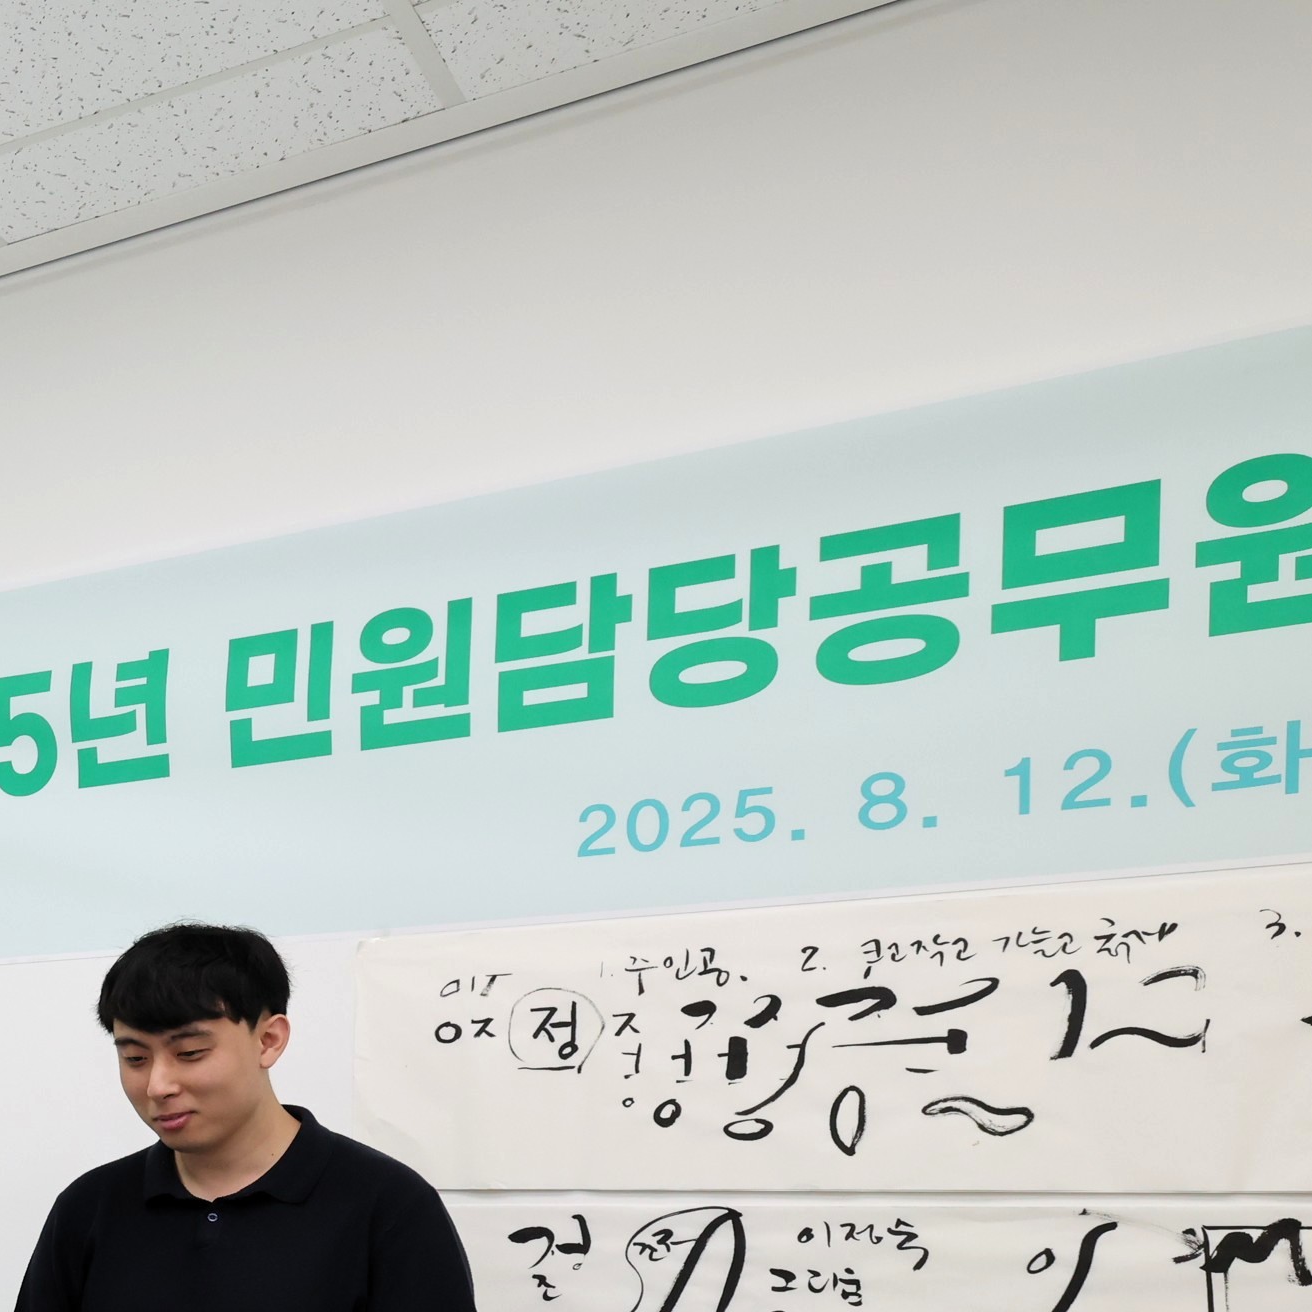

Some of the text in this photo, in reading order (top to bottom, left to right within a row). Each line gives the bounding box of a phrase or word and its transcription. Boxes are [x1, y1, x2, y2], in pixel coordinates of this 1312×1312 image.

[577, 787, 806, 857] 2025.
[858, 772, 938, 830] 8.
[801, 946, 827, 972] 2.
[1260, 909, 1301, 940] 3.
[530, 1001, 578, 1060] 정
